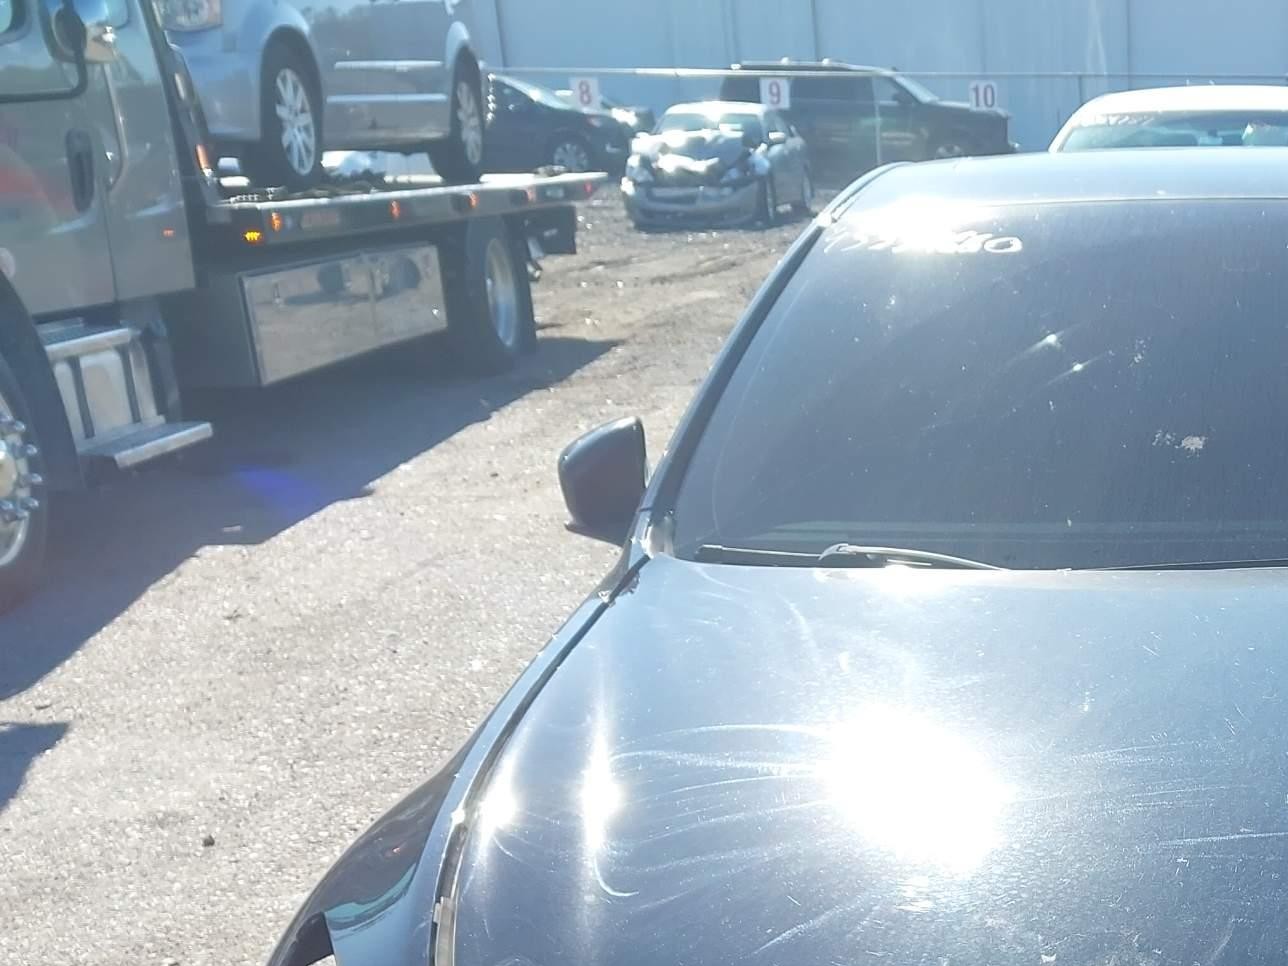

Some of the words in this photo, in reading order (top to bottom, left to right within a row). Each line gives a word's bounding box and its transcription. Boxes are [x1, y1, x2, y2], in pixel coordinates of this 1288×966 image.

[579, 80, 592, 106] 8
[768, 80, 781, 105] 9
[971, 84, 995, 108] 10
